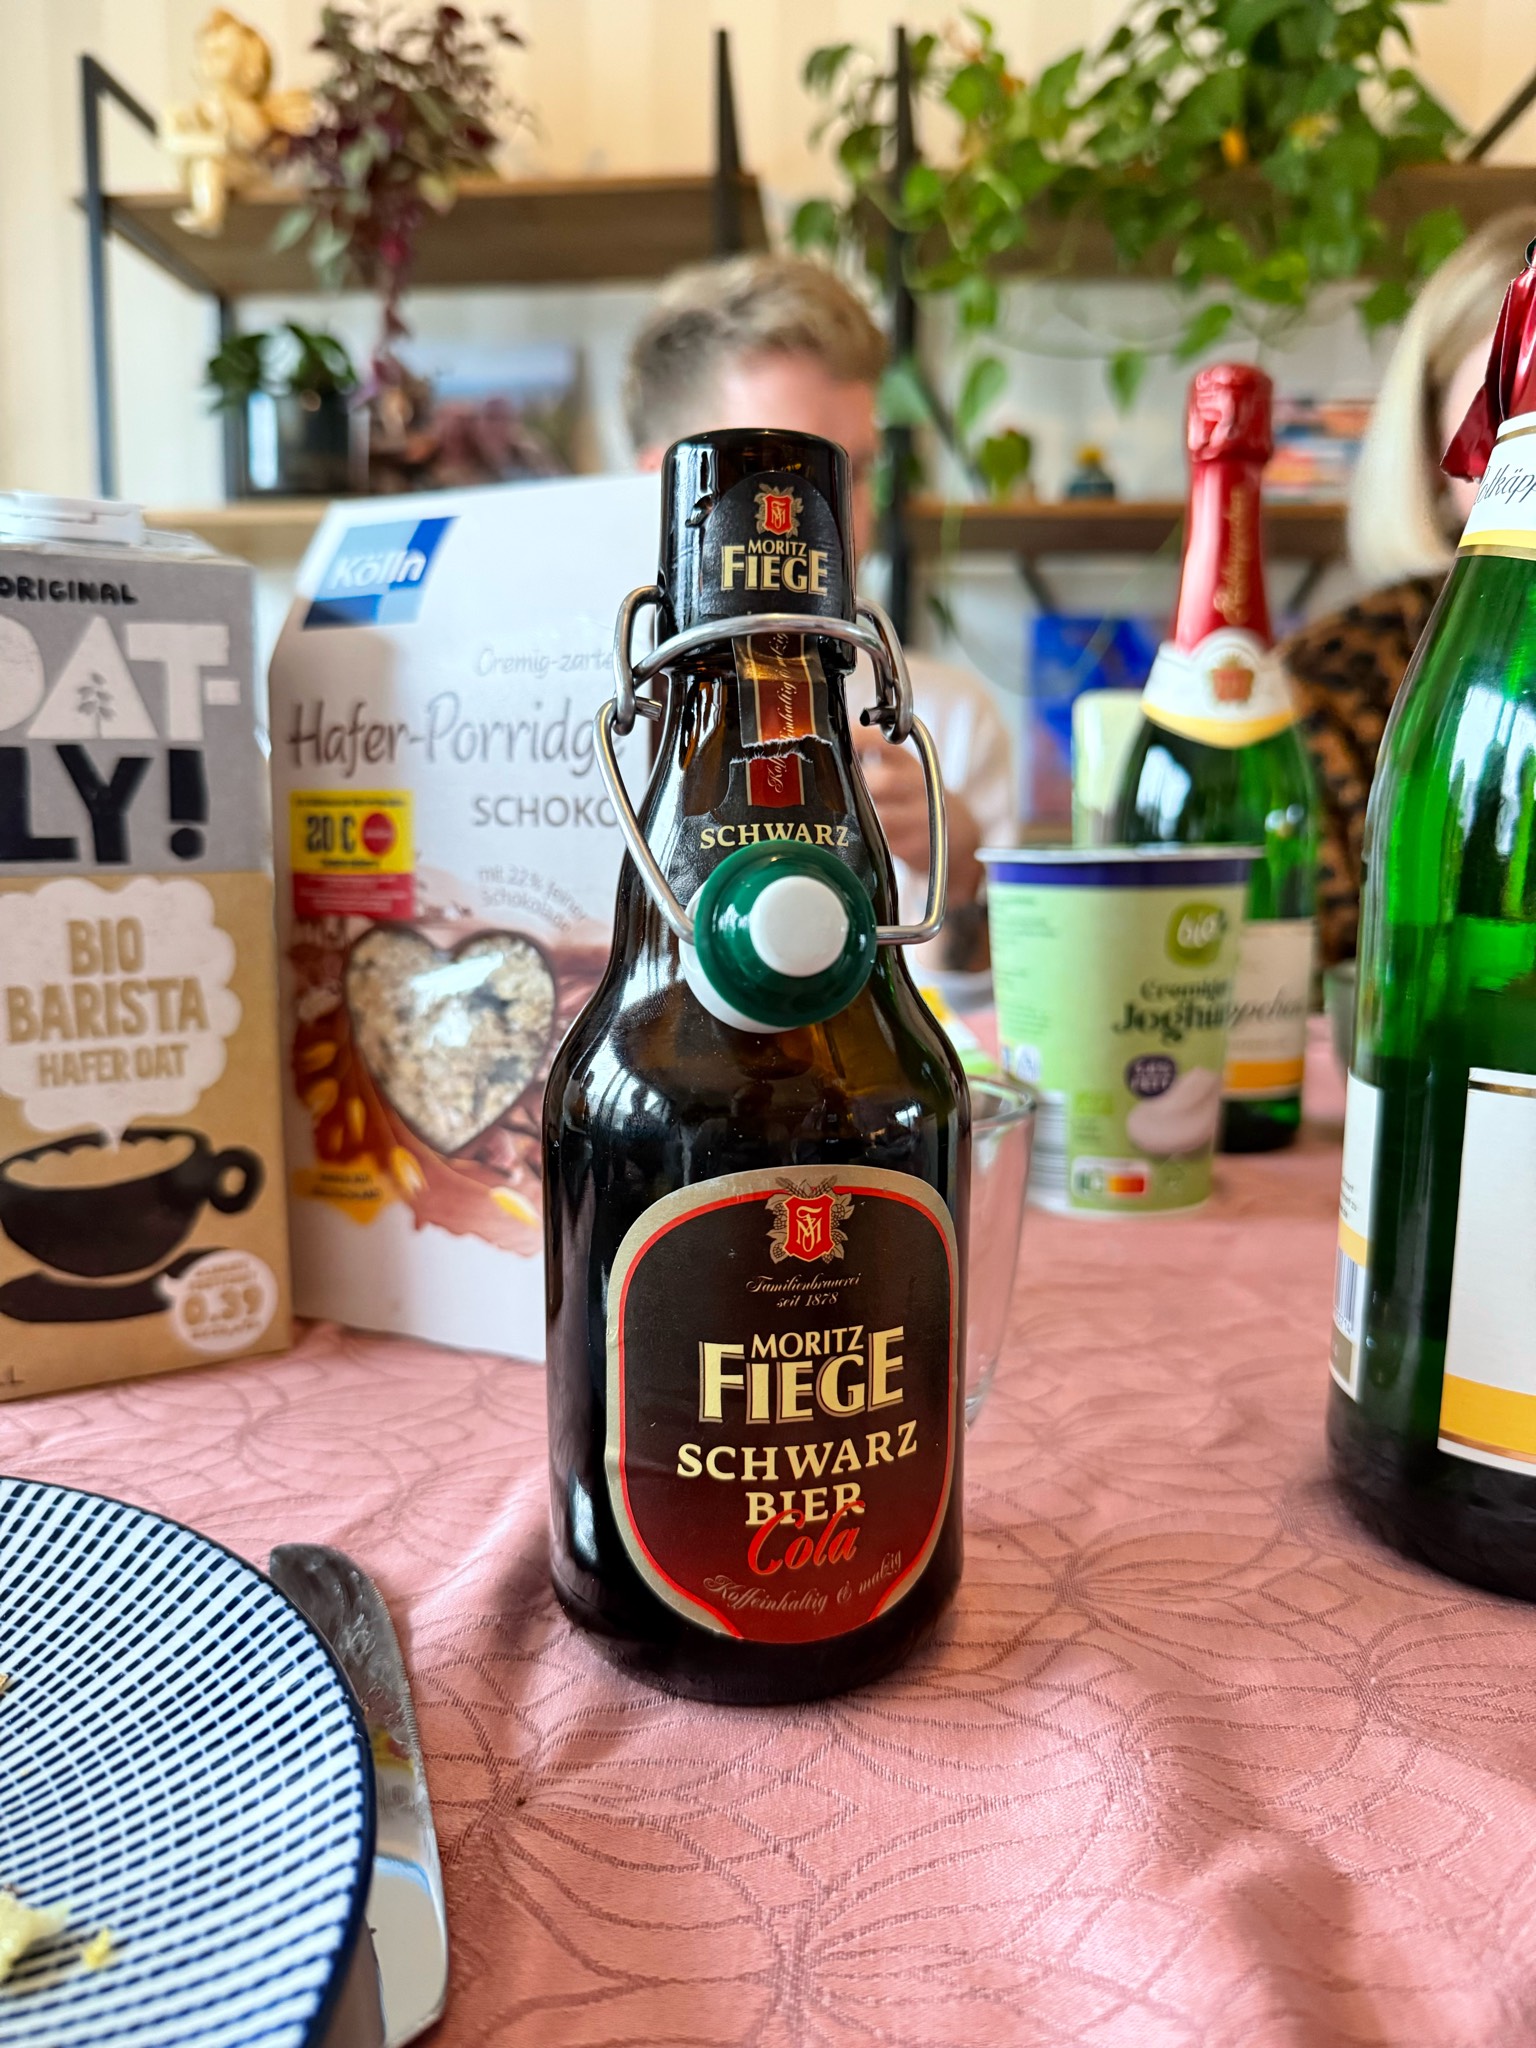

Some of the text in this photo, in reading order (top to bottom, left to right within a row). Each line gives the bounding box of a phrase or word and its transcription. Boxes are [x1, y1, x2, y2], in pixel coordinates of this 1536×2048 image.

[327, 551, 427, 589] Kölln
[748, 539, 807, 557] MORITZ
[0, 576, 139, 606] ORIGINAL
[721, 545, 828, 597] FIEGE
[0, 744, 209, 865] LY!
[700, 822, 849, 850] SCHWARZ
[66, 917, 144, 976] BIO
[6, 976, 210, 1043] BARISTA
[37, 1043, 188, 1088] HAFER OAT
[745, 1272, 863, 1293] Familienbrauerei
[776, 1291, 840, 1309] seit 1878
[751, 1325, 864, 1359] MORITZ
[698, 1326, 905, 1425] FIEGE
[677, 1419, 918, 1481] SCHWARZ
[745, 1482, 865, 1525] BIER
[747, 1500, 866, 1575] Cola
[702, 1550, 902, 1616] Koffeinhaltig & malzig
